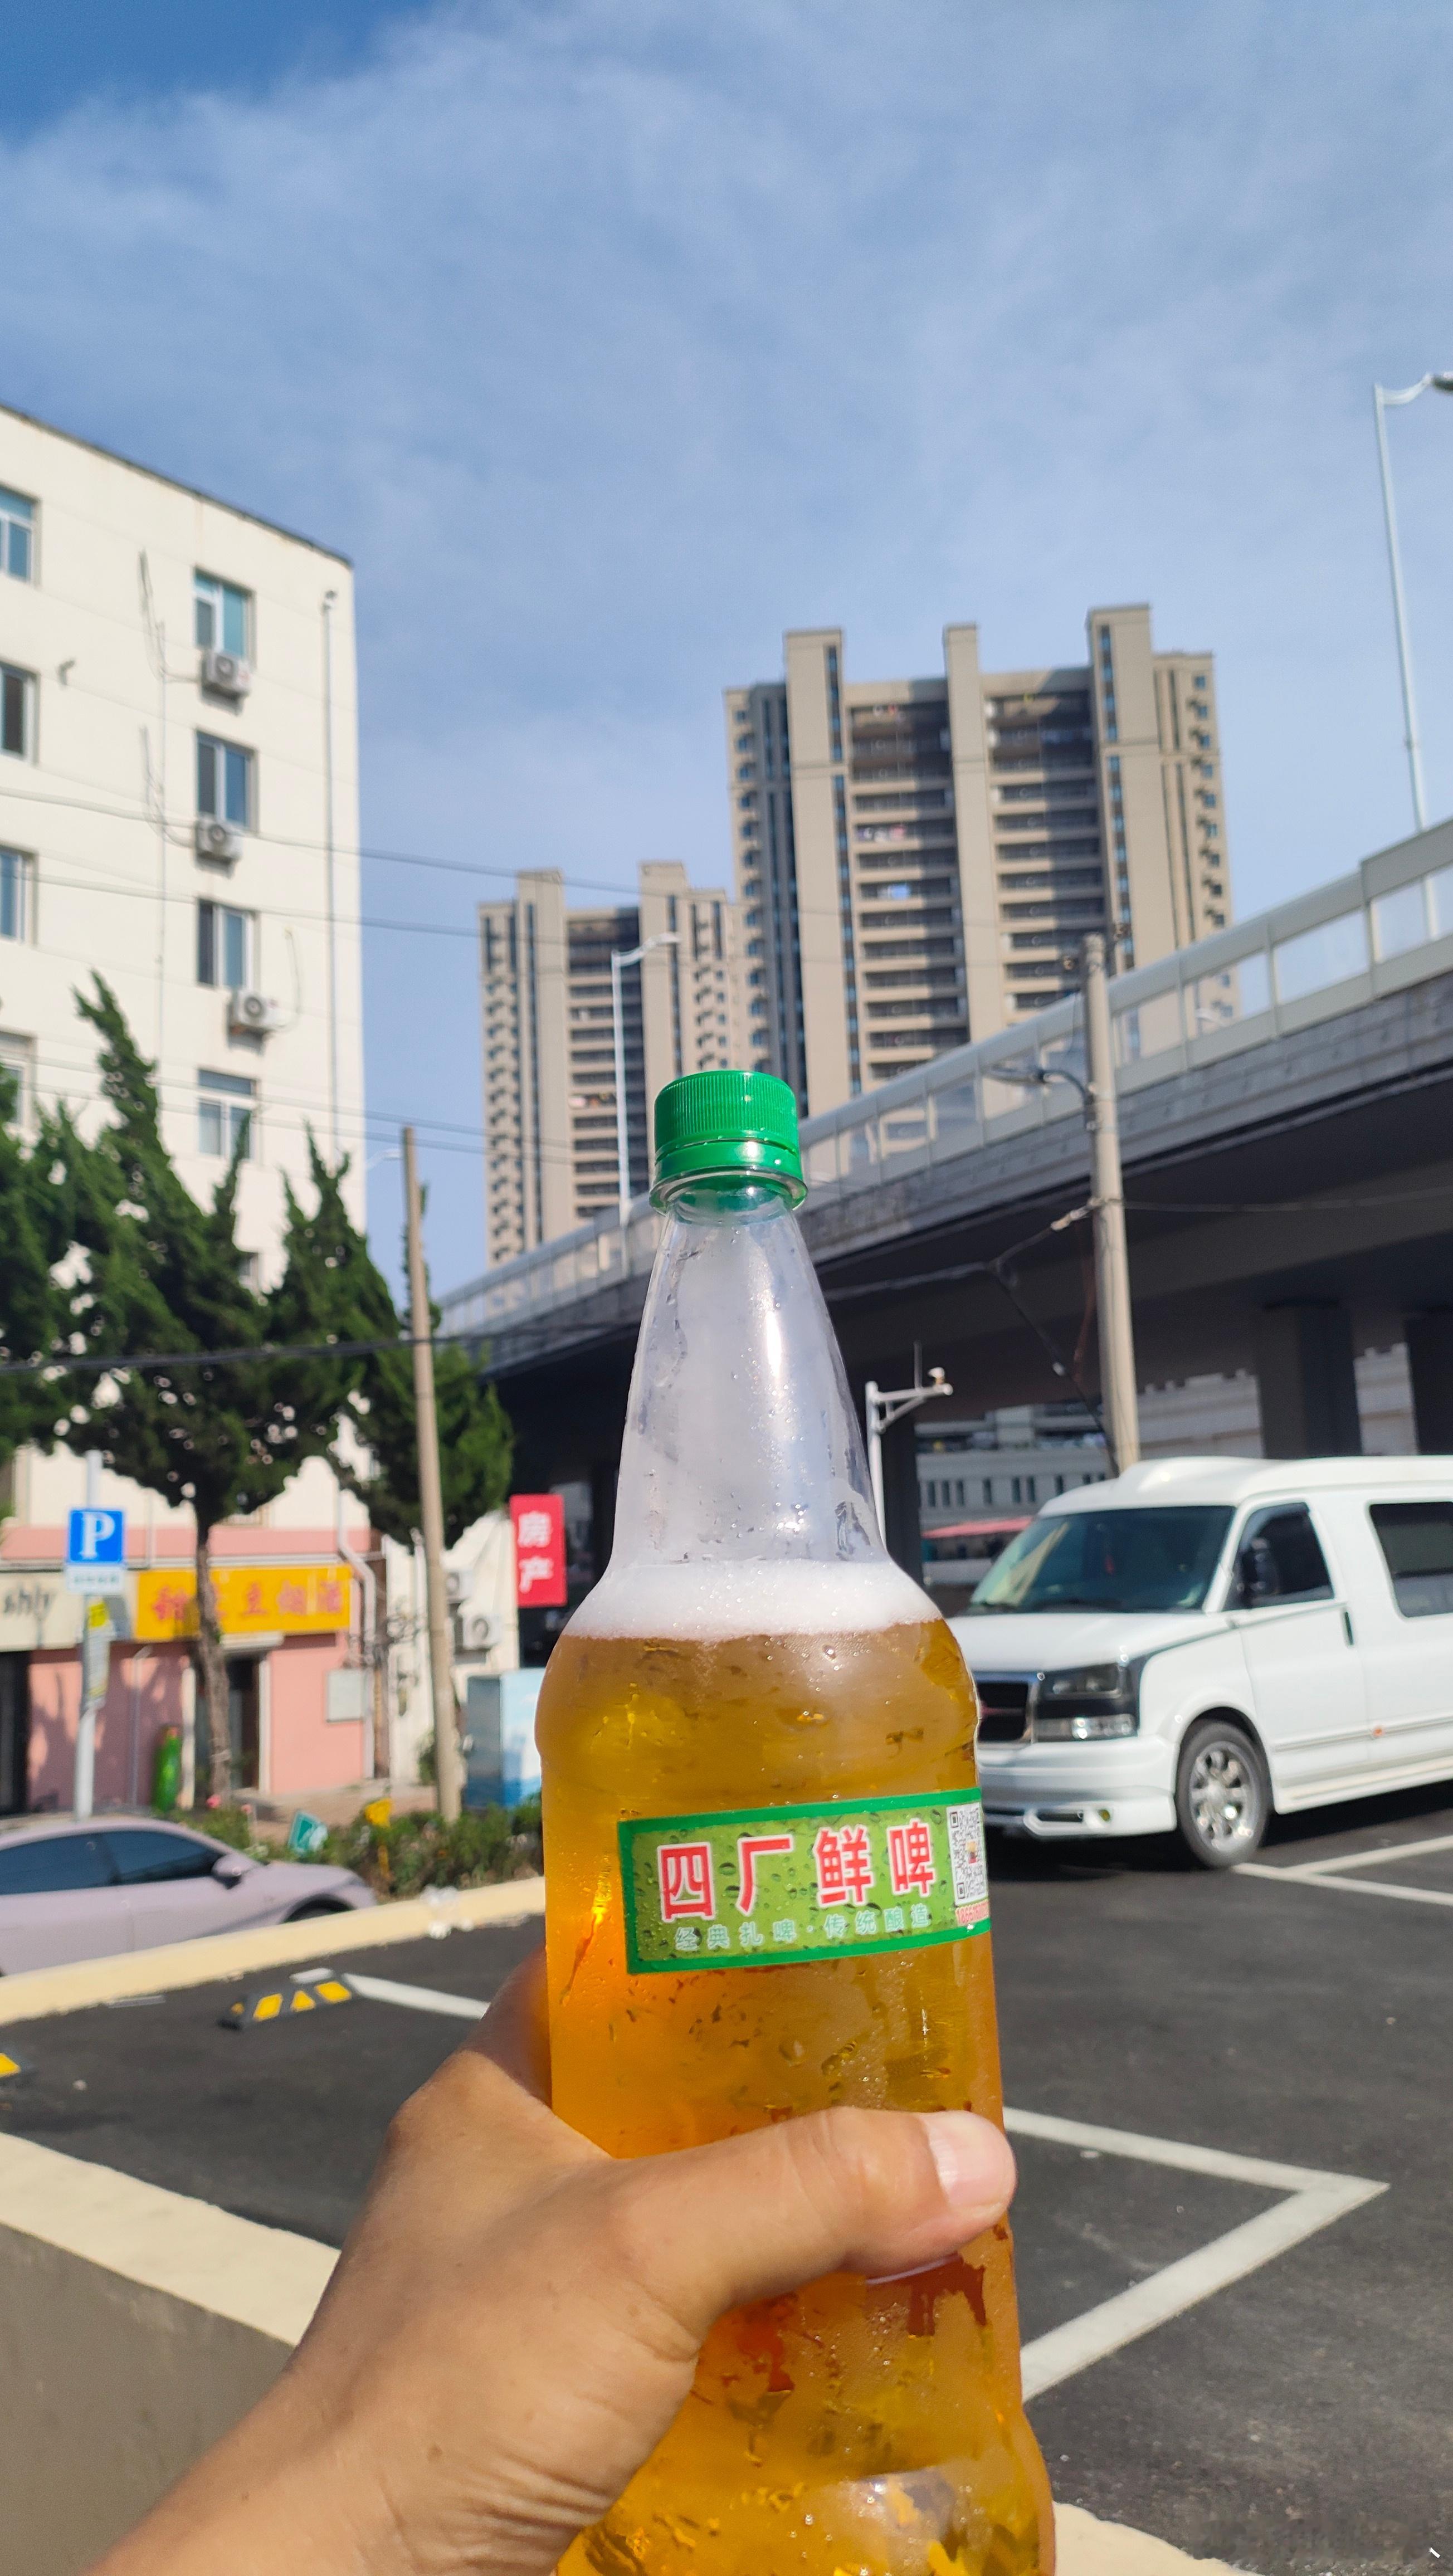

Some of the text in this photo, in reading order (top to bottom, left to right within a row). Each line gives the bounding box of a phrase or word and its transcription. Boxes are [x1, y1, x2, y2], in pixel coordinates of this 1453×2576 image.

[81, 1511, 115, 1559] P
[518, 1510, 554, 1593] 房产
[657, 1818, 937, 1923] 四厂鲜啤
